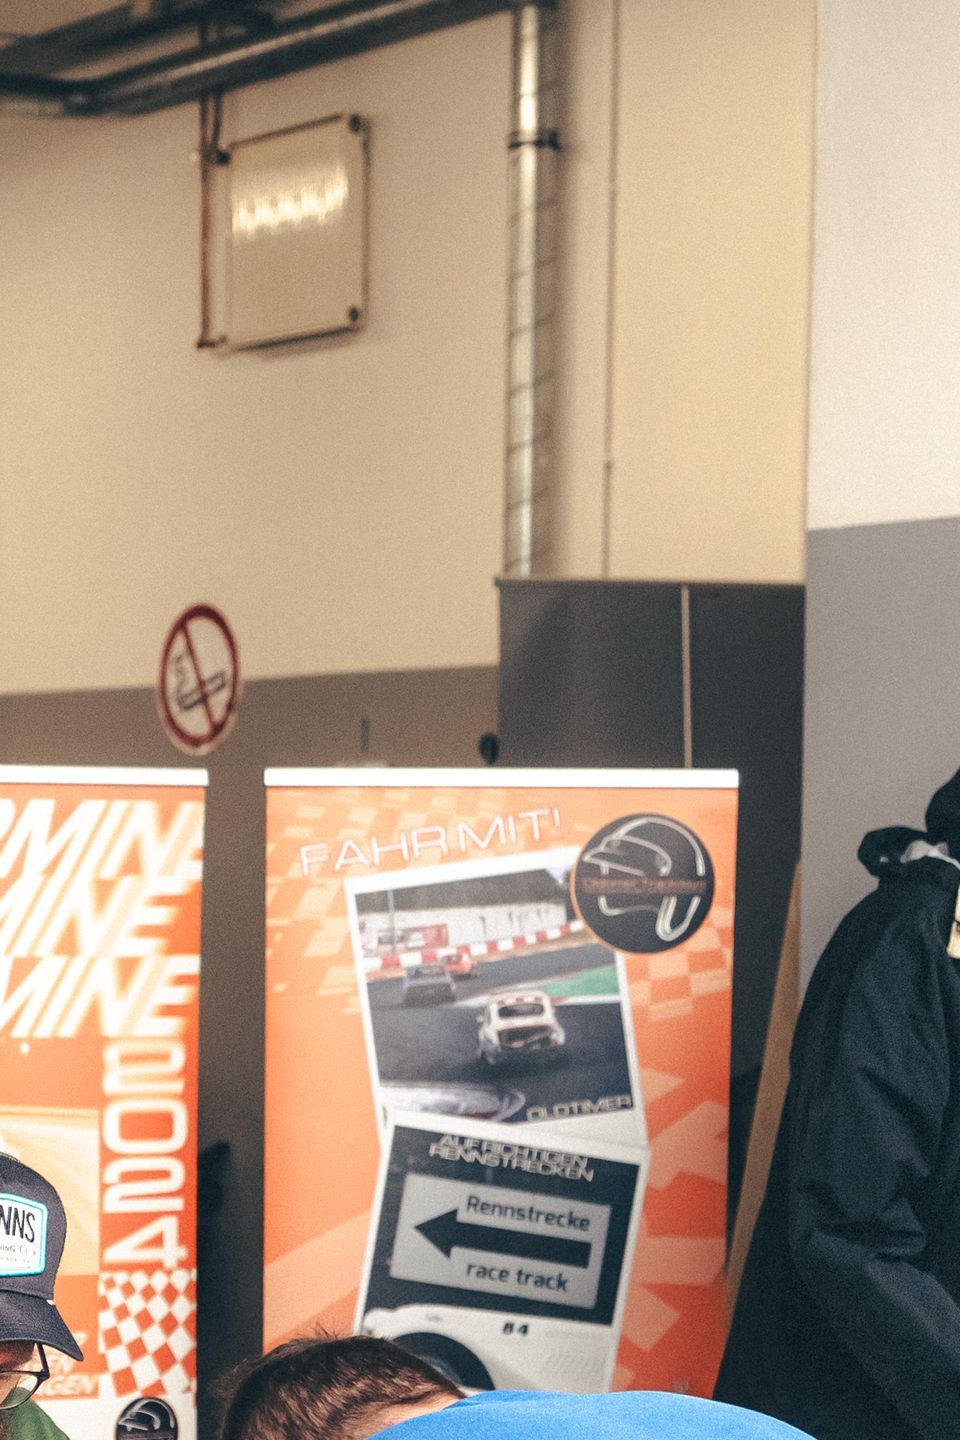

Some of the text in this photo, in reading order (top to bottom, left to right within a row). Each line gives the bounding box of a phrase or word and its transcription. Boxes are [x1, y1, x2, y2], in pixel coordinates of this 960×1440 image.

[300, 808, 561, 876] FAHR MIT!
[101, 1037, 188, 1268] 2024
[466, 1195, 591, 1232] Rennstrecke
[466, 1263, 569, 1292] race track
